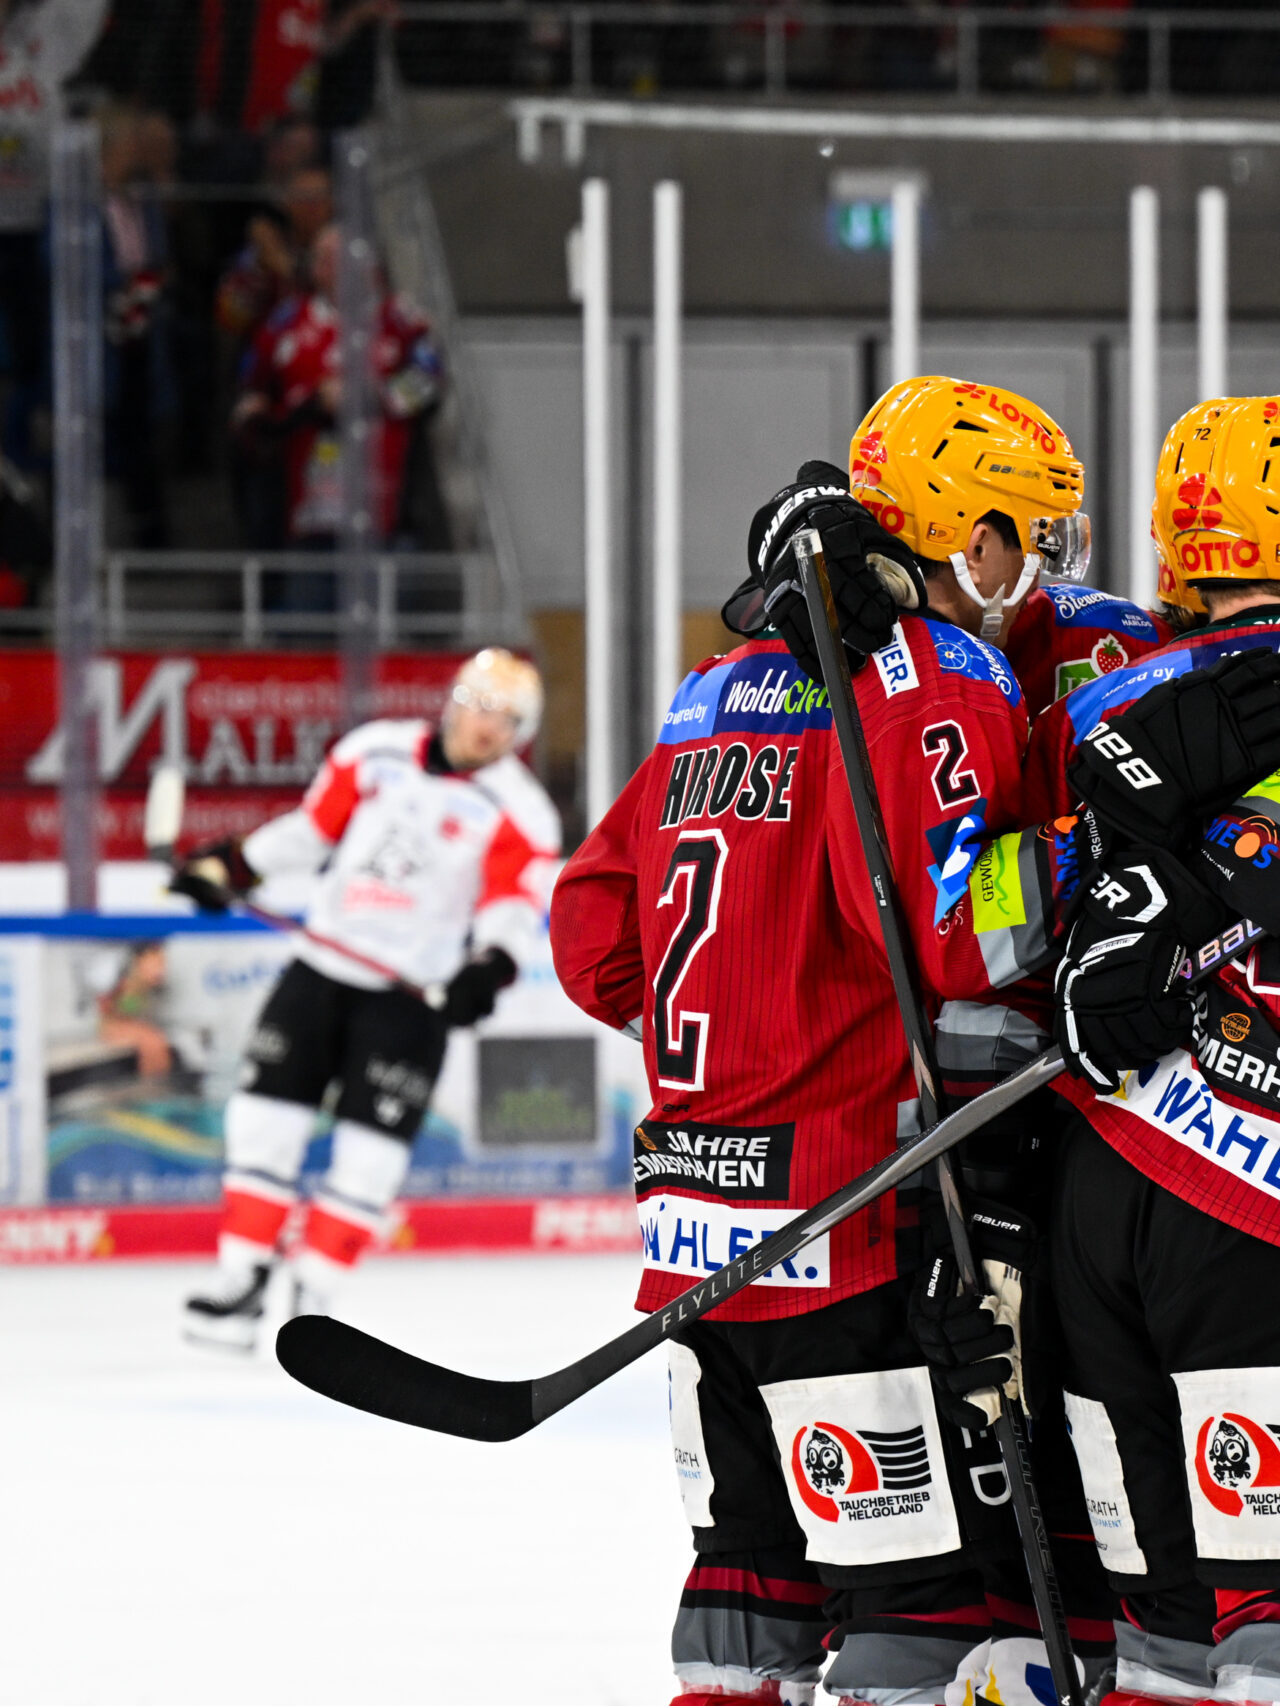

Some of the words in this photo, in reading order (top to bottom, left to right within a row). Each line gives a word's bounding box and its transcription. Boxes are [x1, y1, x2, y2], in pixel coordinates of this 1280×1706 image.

[988, 393, 1057, 455] LOTTO
[1193, 427, 1211, 441] 72
[664, 702, 695, 725] owered
[694, 701, 709, 723] by
[921, 719, 982, 812] 2
[658, 741, 800, 831] HIROSE
[652, 827, 730, 1092] 2
[666, 1130, 772, 1158] JAHRE
[972, 1212, 1022, 1232] BAUER
[662, 1249, 764, 1333] FLYLITE
[926, 1257, 944, 1298] BAUER
[839, 1490, 931, 1512] TAUCHBETRIEB
[849, 1502, 924, 1522] HELGOLAND
